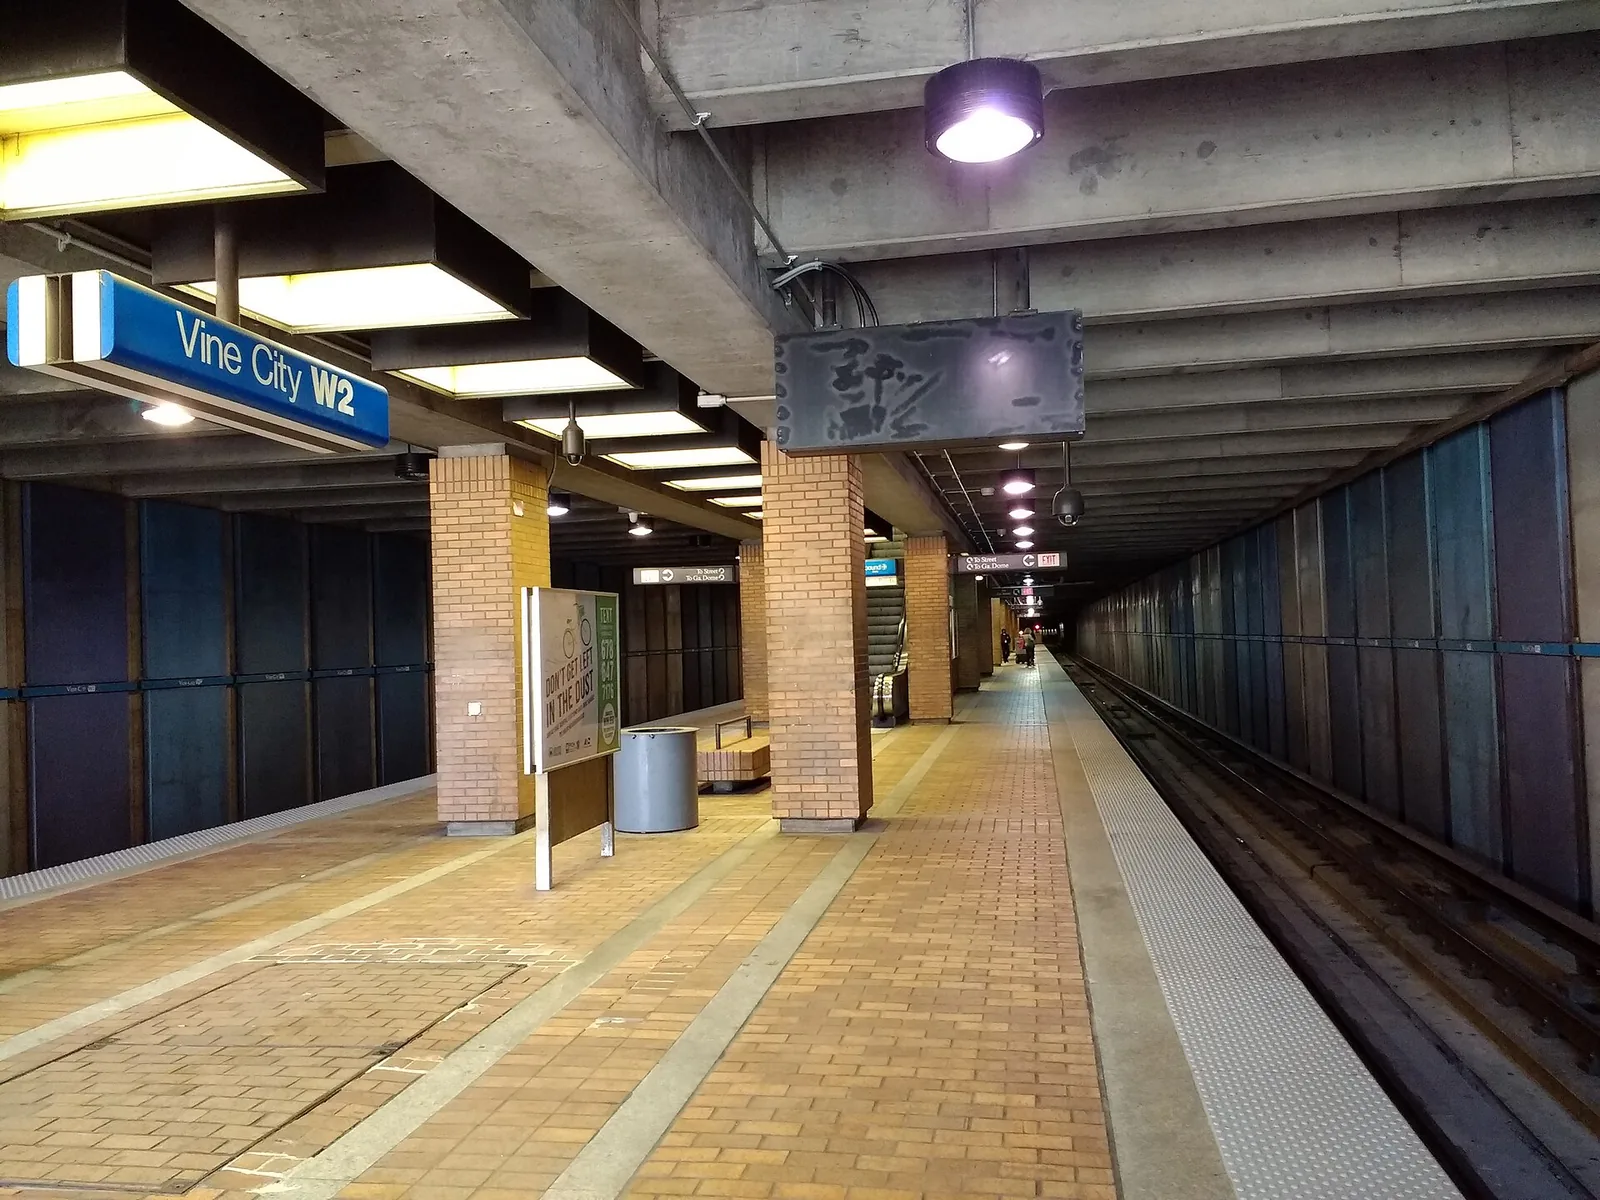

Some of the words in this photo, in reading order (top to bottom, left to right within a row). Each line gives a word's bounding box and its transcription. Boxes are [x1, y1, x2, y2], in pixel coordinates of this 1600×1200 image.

[176, 310, 242, 375] Vine
[251, 343, 303, 404] City
[310, 365, 356, 417] W2
[1041, 554, 1057, 566] EXIT
[600, 607, 613, 623] TEXT
[601, 639, 614, 660] 678
[546, 667, 565, 698] DON'T
[567, 657, 578, 682] GET
[580, 646, 593, 673] LEFT
[546, 699, 555, 728] IN
[557, 685, 573, 718] THE
[575, 669, 593, 704] DUST
